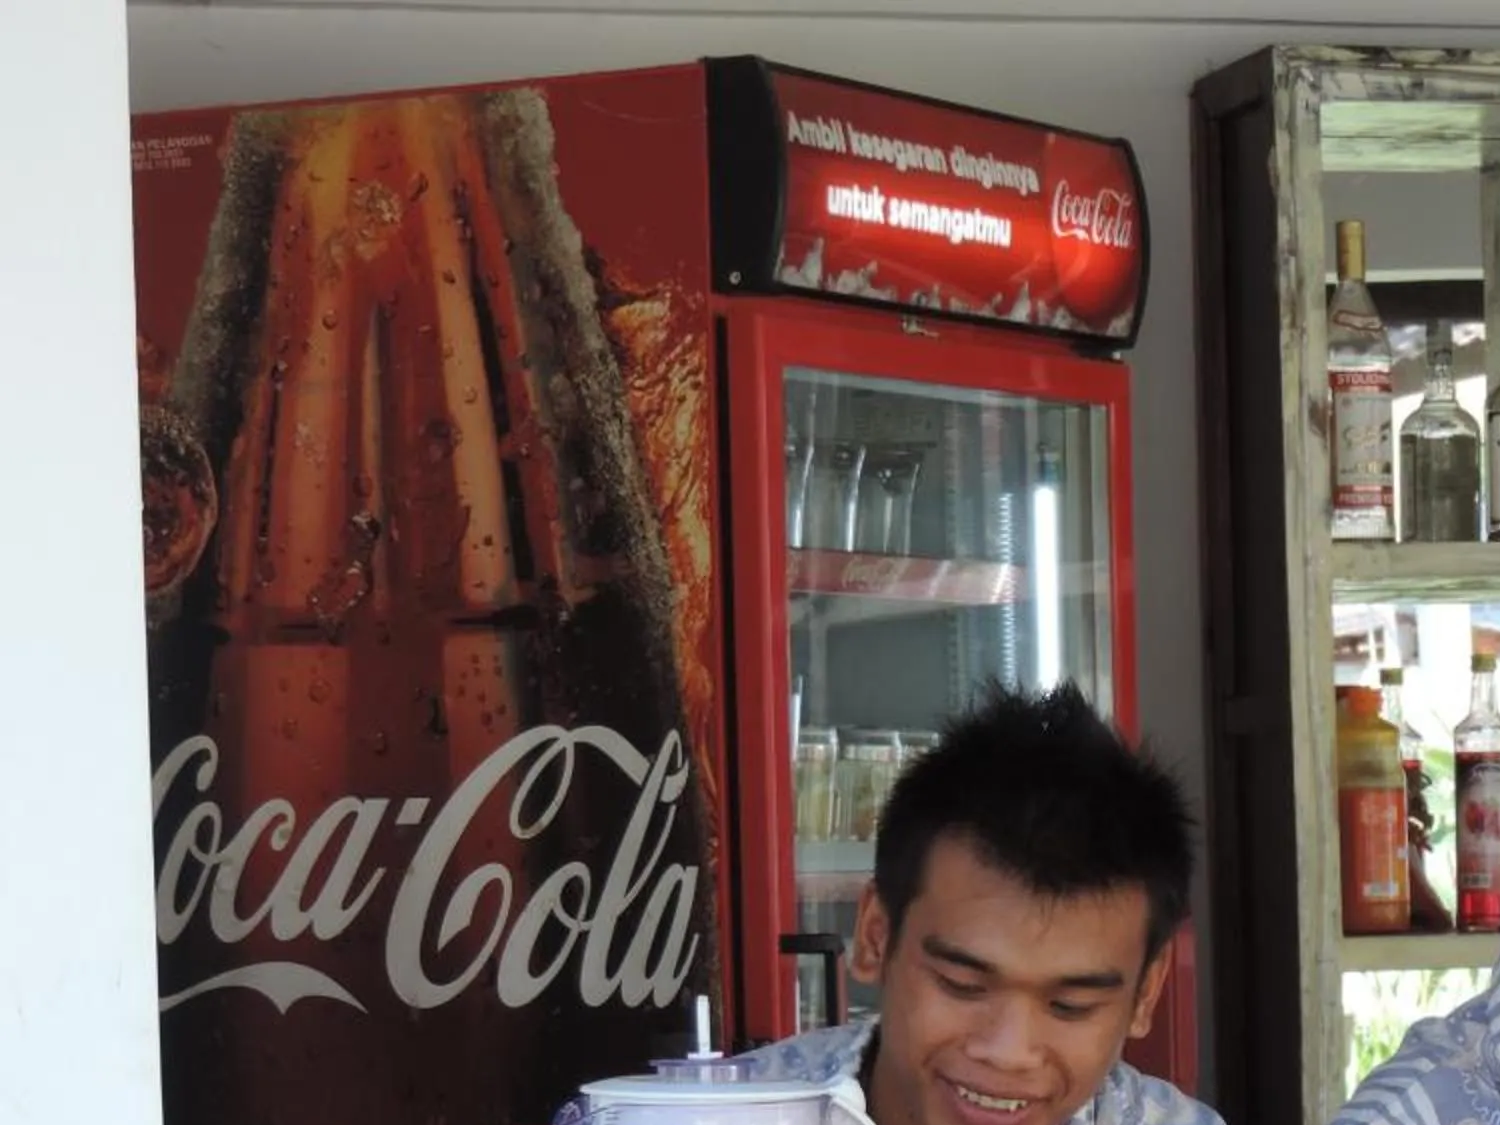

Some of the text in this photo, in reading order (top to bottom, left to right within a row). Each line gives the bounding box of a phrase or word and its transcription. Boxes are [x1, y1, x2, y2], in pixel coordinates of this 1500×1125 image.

[787, 110, 1040, 195] Ambil kesegaran dinginnya
[827, 184, 1012, 247] untuk semangatmu
[1052, 178, 1133, 249] Coca-Cola
